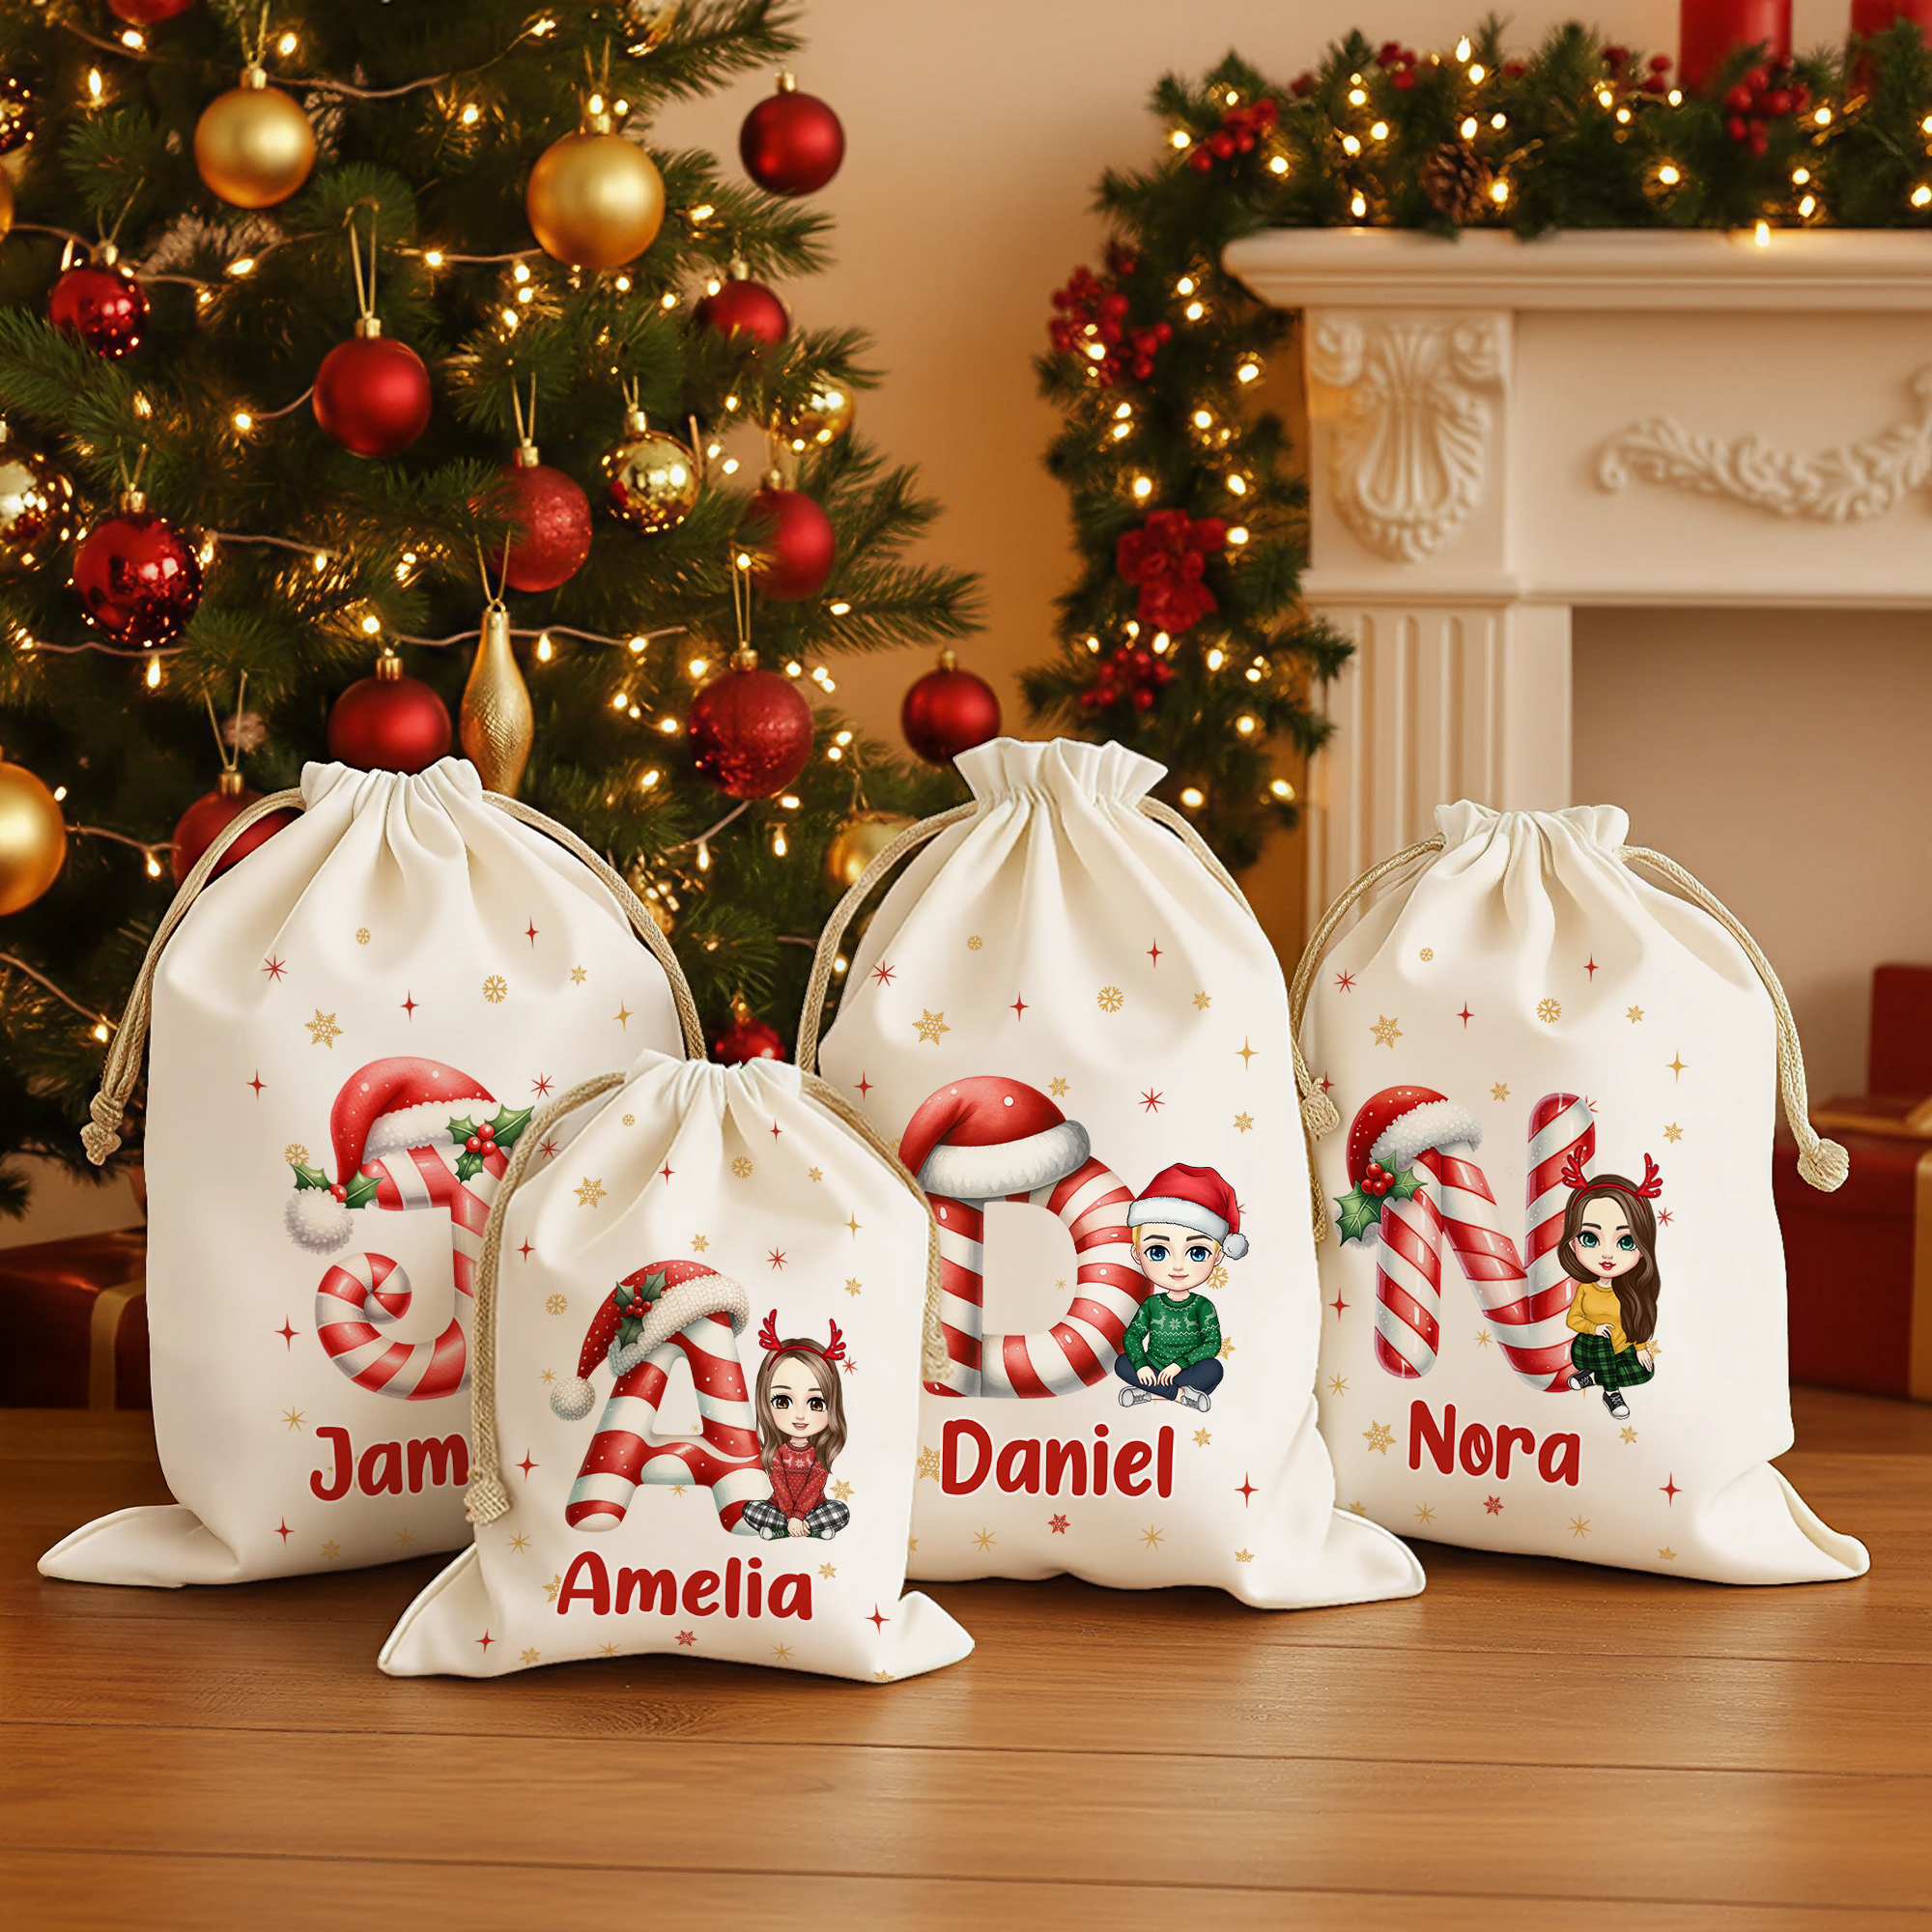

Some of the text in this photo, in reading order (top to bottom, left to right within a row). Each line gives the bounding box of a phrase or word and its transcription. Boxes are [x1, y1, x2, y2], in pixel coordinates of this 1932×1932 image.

[309, 1426, 475, 1501] Jam
[941, 1418, 1175, 1498] Daniel
[1408, 1400, 1580, 1487] Nora
[556, 1550, 813, 1621] Amelia
